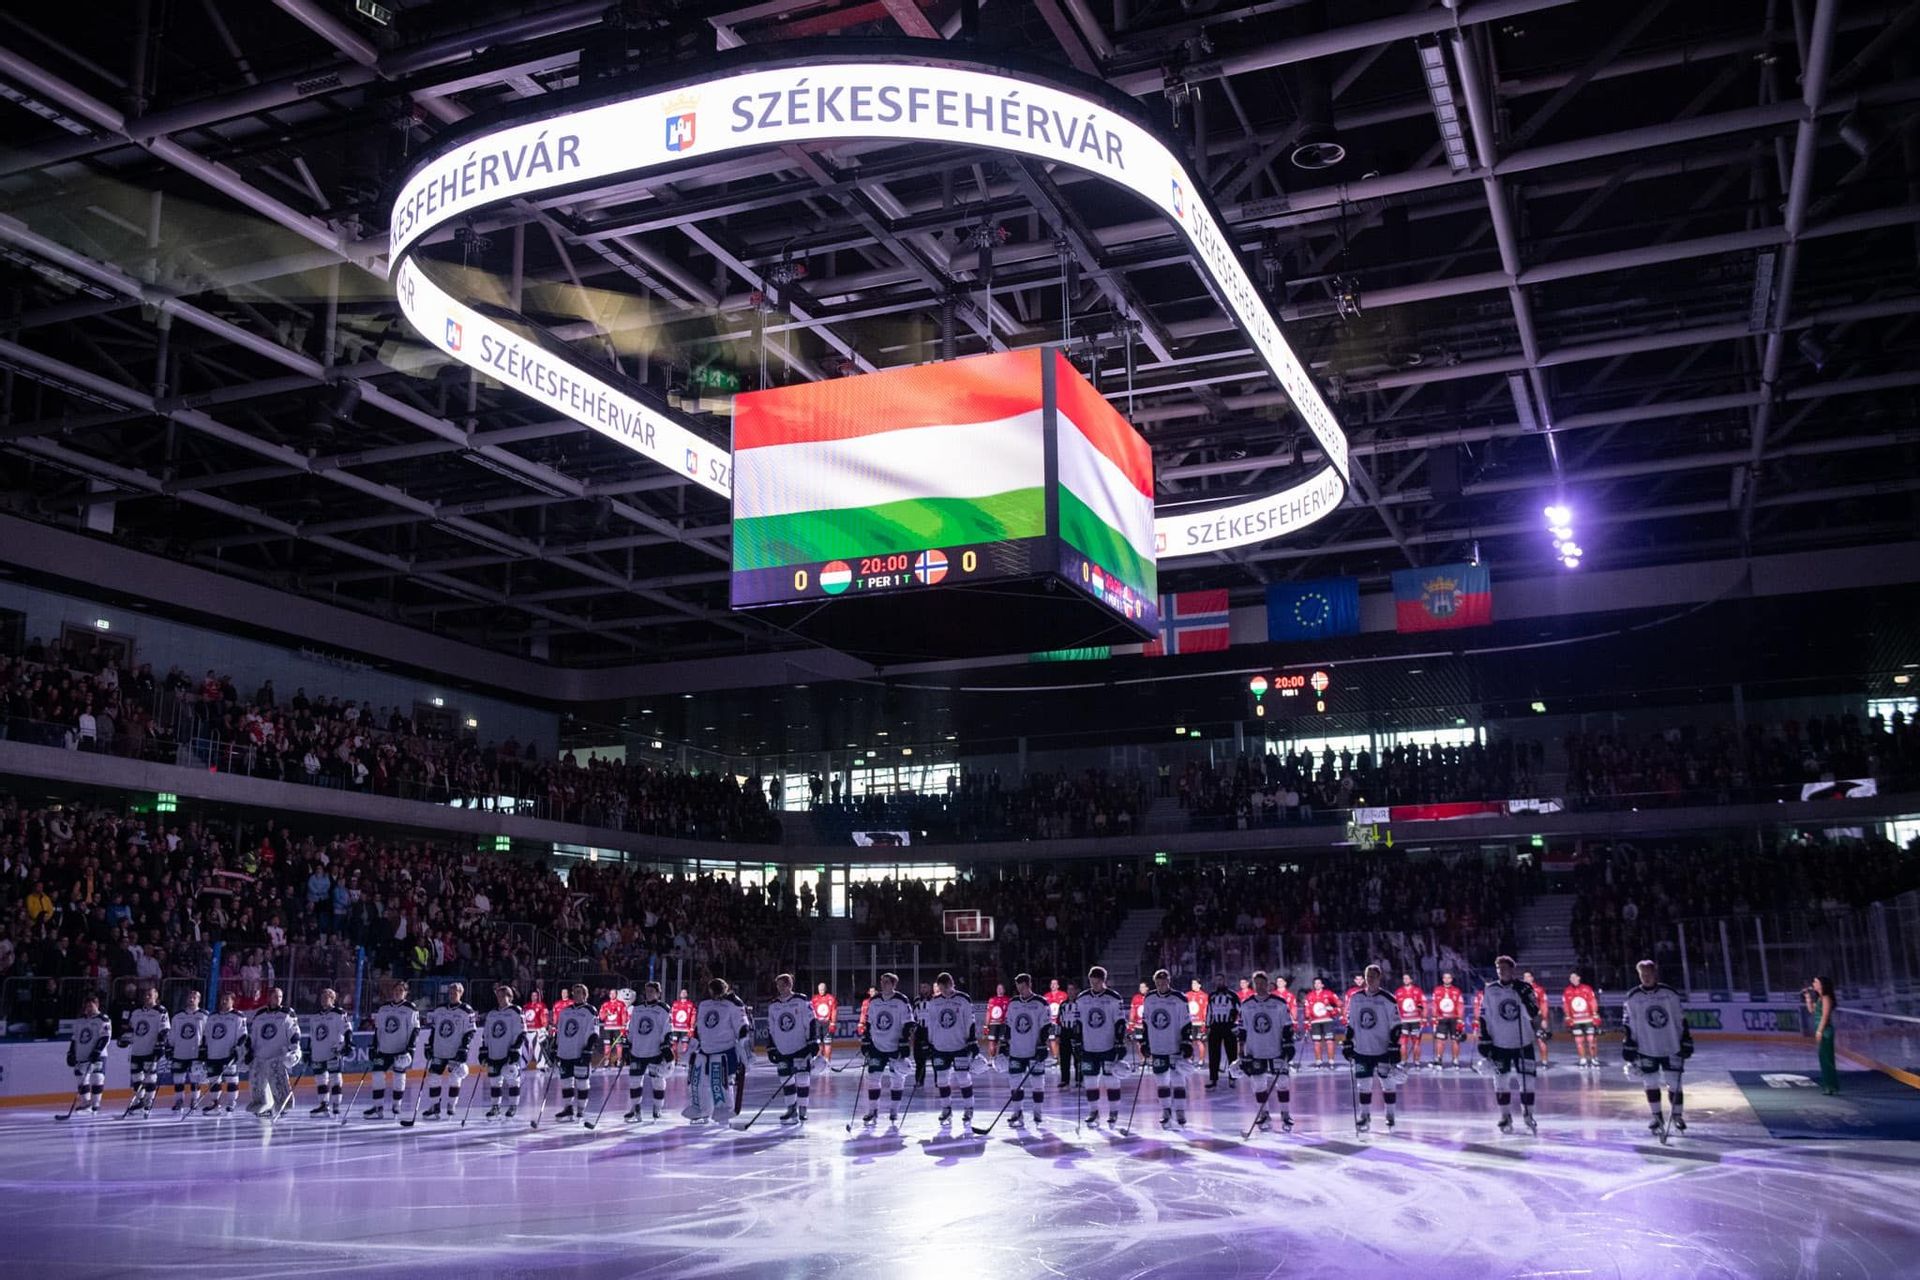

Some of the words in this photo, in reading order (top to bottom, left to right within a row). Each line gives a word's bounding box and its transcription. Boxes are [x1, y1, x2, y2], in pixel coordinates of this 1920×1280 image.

[731, 78, 1126, 170] SZÉKESFEHÉRVÁR
[480, 335, 656, 450] SZÉKESFEHÉRVÁR
[861, 555, 908, 574] 20:00
[962, 550, 977, 573] 0
[794, 570, 808, 591] 0
[868, 576, 891, 588] PER
[1275, 675, 1305, 689] 20:00
[1256, 705, 1264, 717] 0
[1316, 700, 1325, 712] 0
